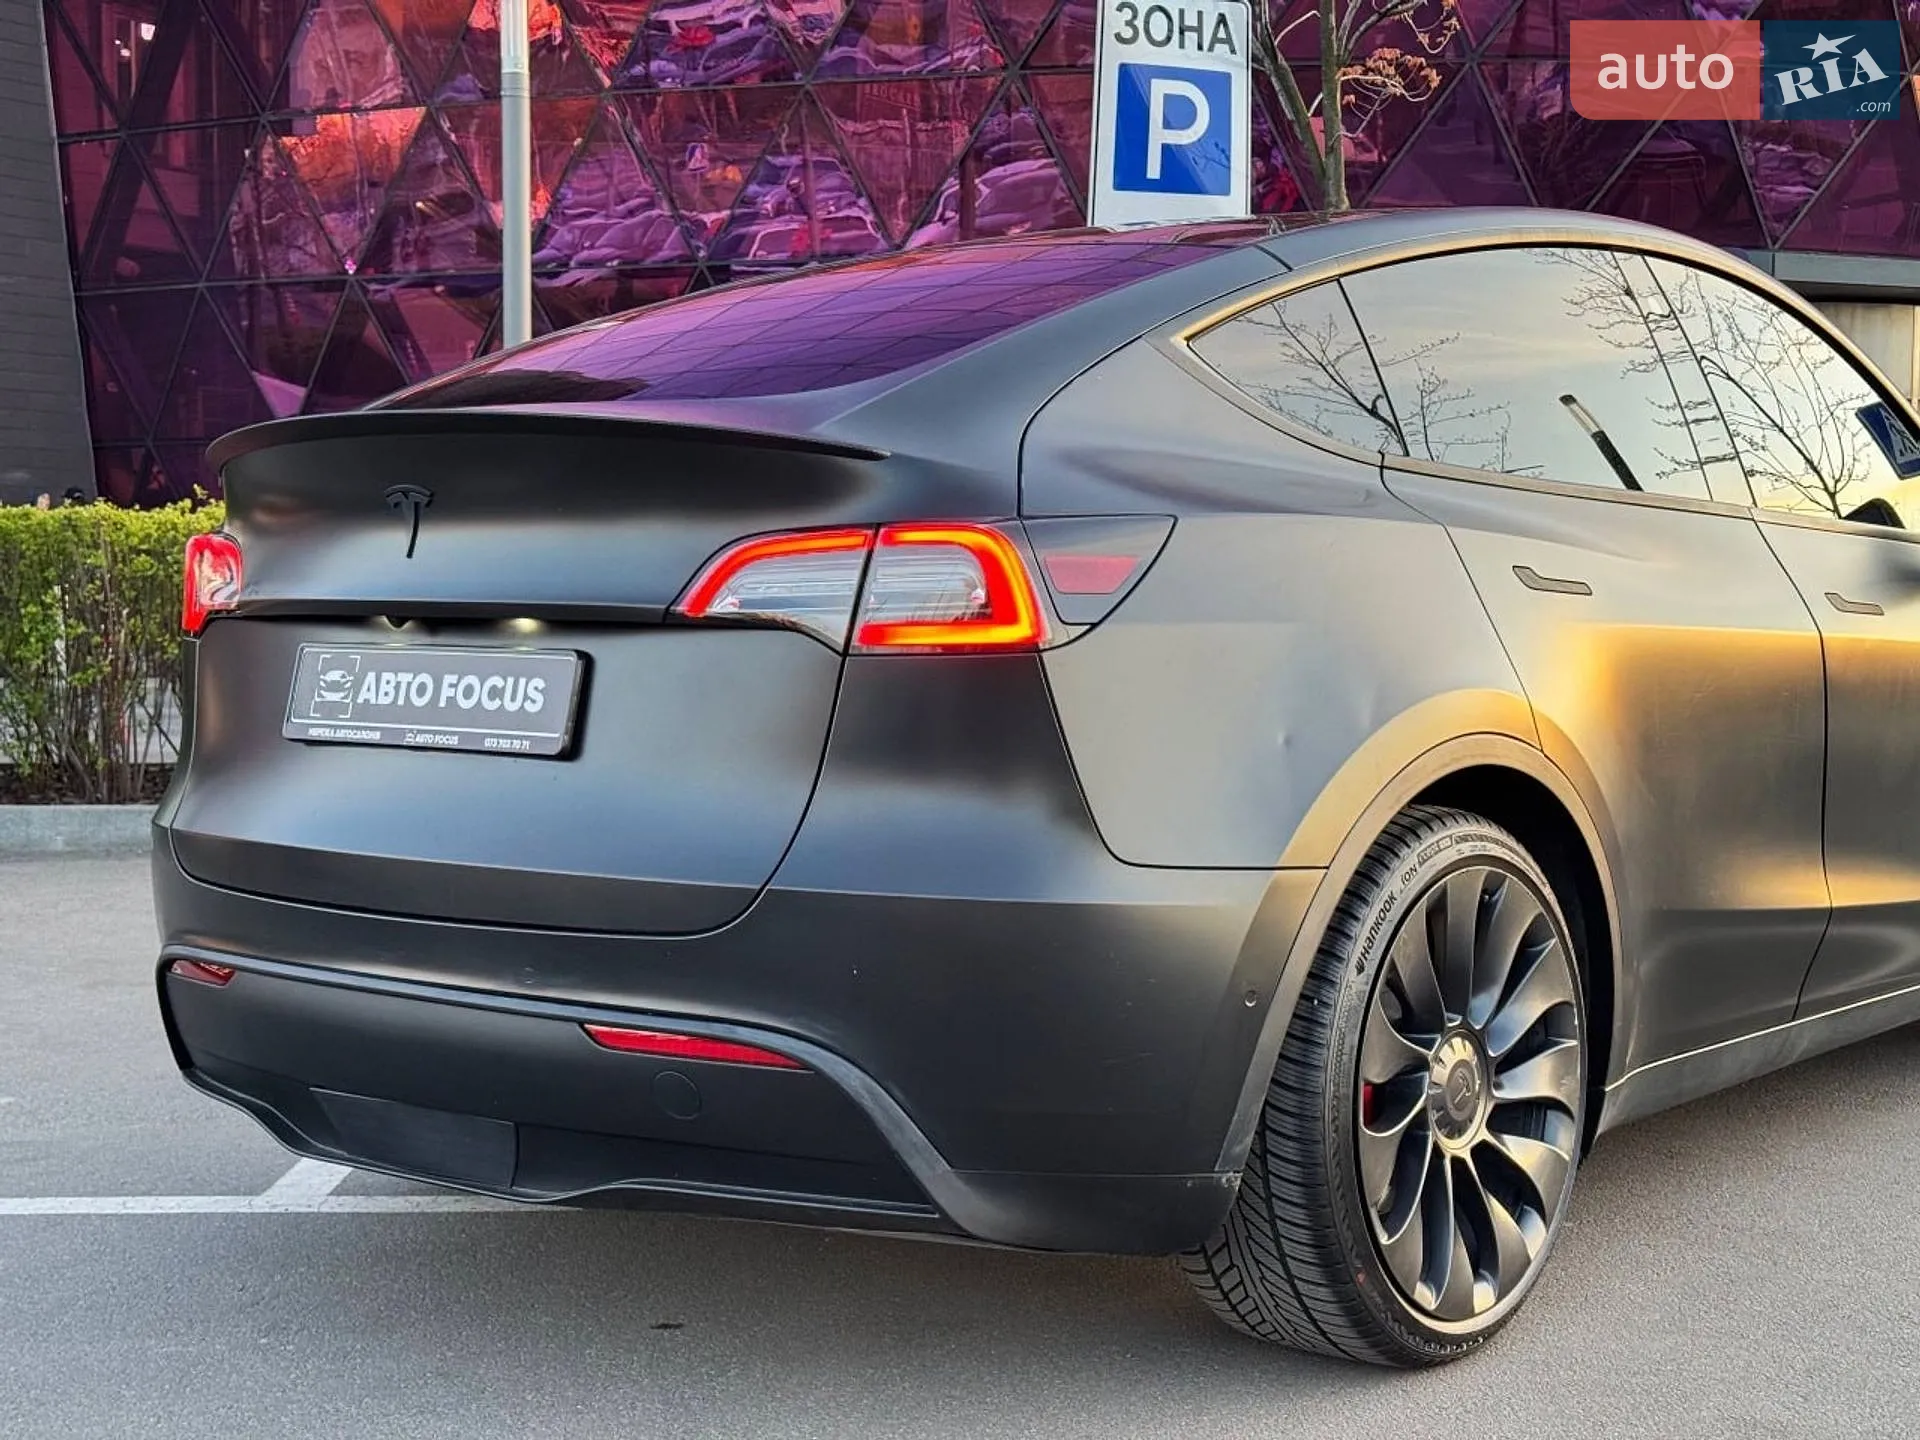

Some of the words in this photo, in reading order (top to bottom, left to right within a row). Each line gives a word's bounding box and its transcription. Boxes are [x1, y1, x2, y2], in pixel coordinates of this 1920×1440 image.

[1114, 2, 1237, 55] ЗОНА
[1146, 78, 1210, 179] P
[356, 671, 434, 707] АВТО
[438, 674, 546, 713] FOCUS
